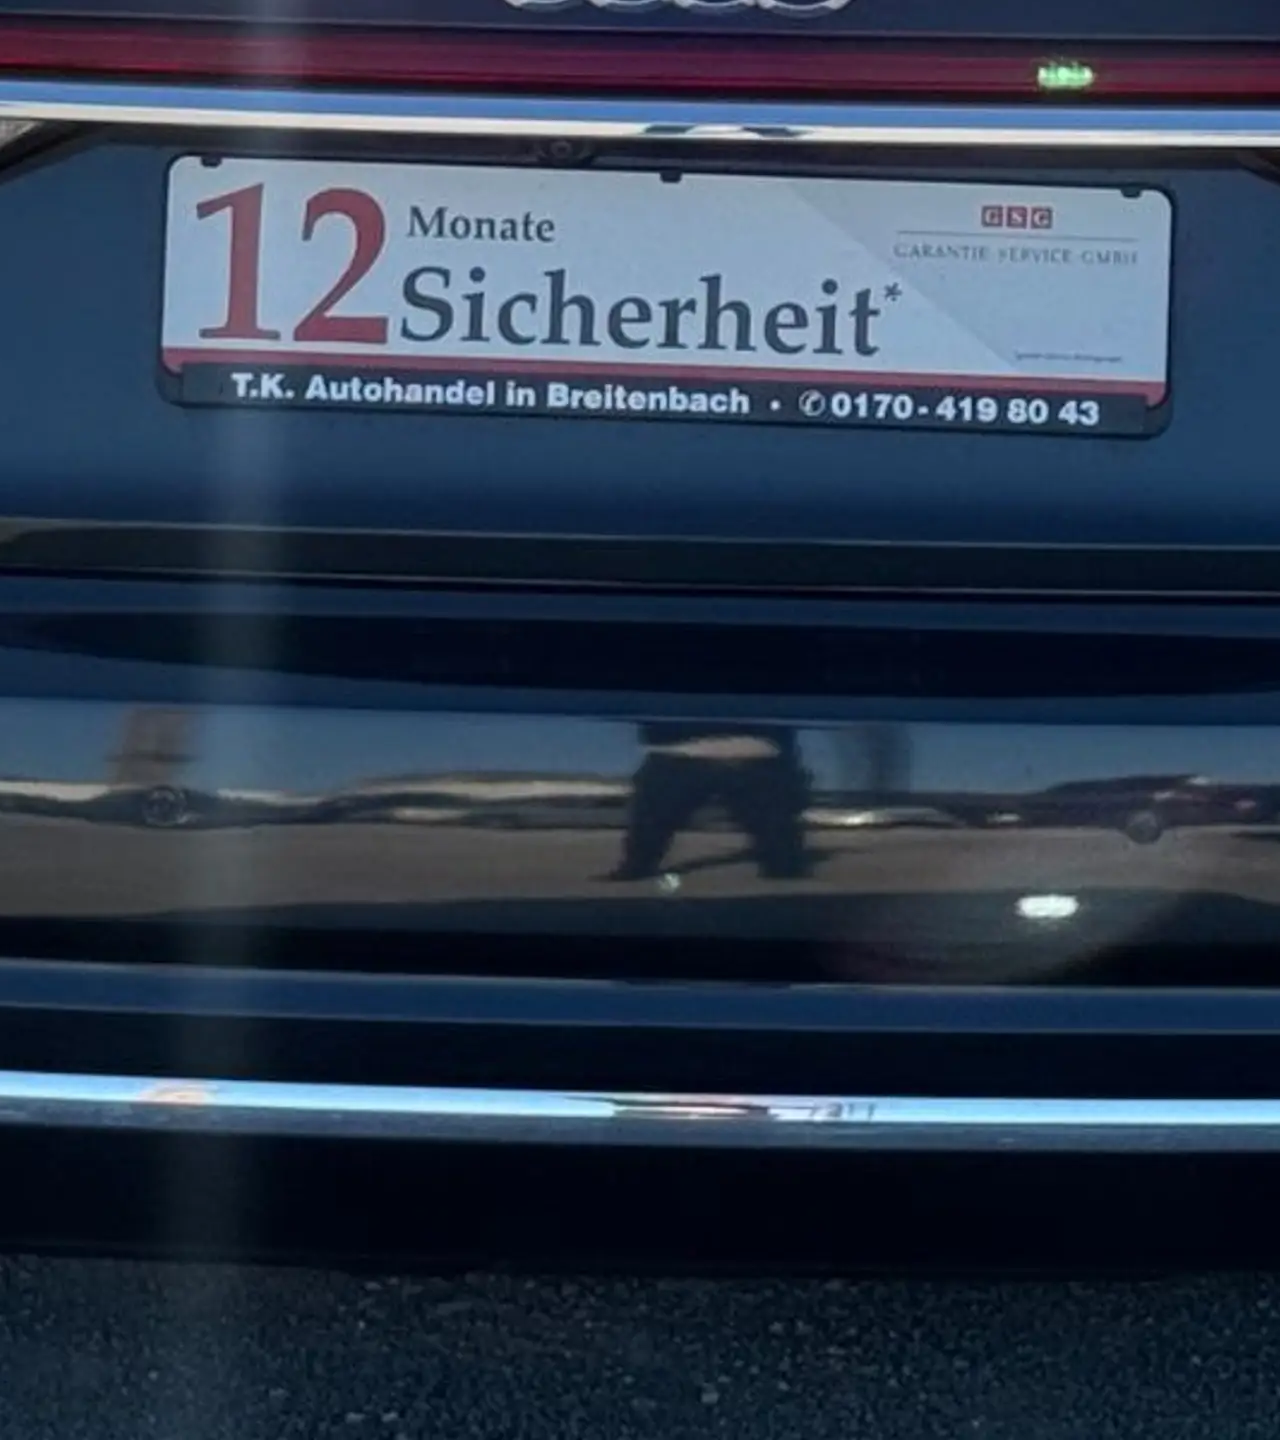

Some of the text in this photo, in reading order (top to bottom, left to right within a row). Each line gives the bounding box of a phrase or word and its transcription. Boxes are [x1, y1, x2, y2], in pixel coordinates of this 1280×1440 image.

[407, 205, 556, 242] Monate
[196, 182, 388, 344] 12
[231, 372, 294, 398] T.K.
[304, 375, 494, 406] Autohandel
[505, 380, 535, 407] in
[546, 383, 750, 415] Breitenbach
[1007, 396, 1049, 425] 80
[1057, 399, 1100, 426] 43
